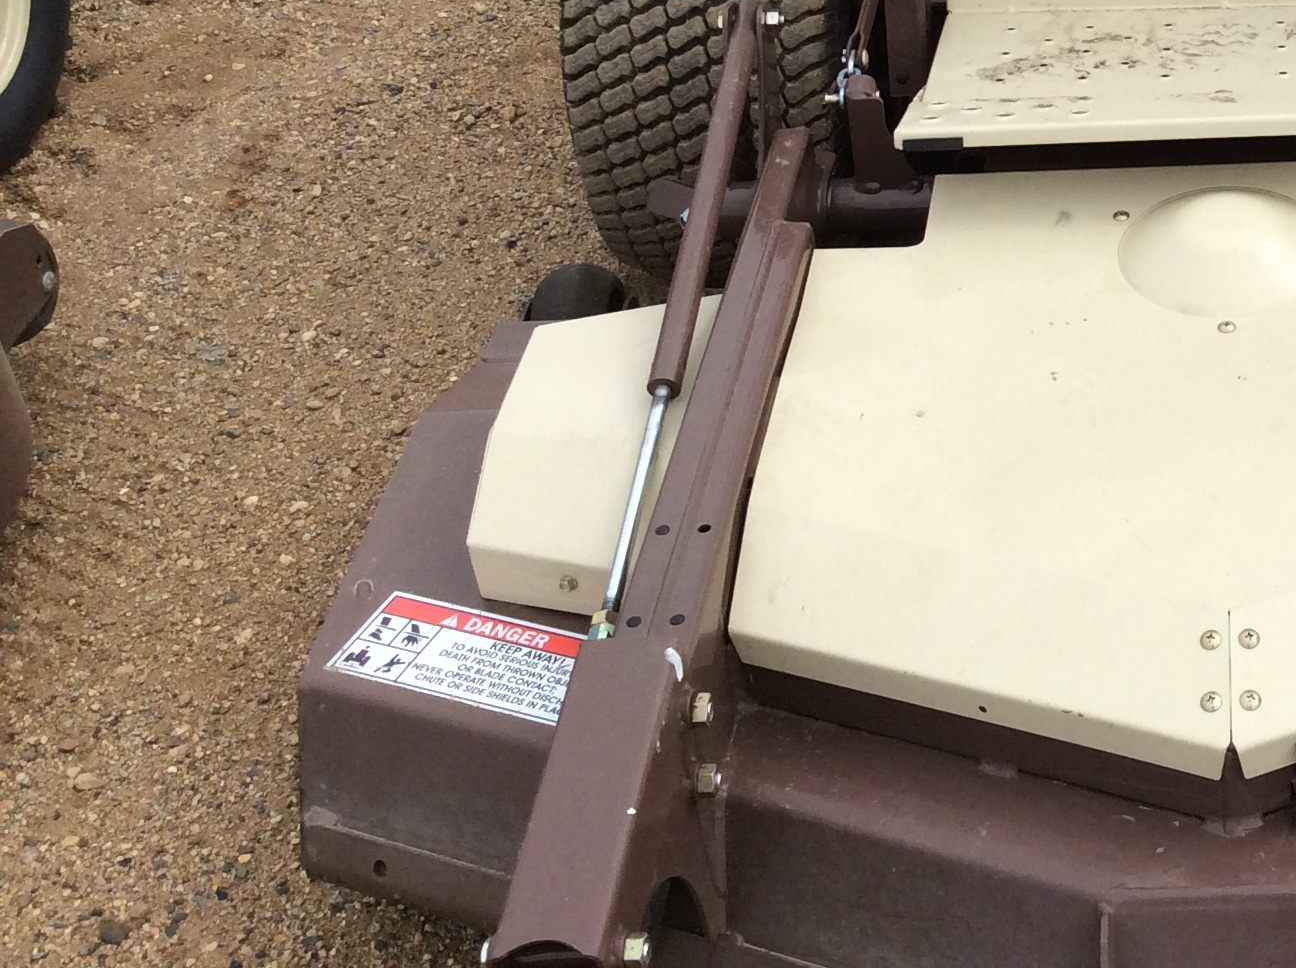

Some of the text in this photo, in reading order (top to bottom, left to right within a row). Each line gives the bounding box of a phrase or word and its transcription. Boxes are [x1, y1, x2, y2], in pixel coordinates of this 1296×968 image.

[463, 617, 550, 648] DANGER
[439, 649, 471, 662] DEATH
[471, 657, 502, 670] FROM
[502, 664, 547, 681] THROWN
[451, 642, 466, 651] TO
[466, 646, 499, 659] AVOID
[499, 654, 540, 669] SERIOUS
[489, 641, 567, 665] KEEP AWAY!
[412, 662, 444, 675] NEVER
[444, 670, 488, 686] OPERATE
[488, 680, 533, 698] WITHOUT
[457, 663, 474, 673] OR
[474, 667, 507, 681] BLADE
[414, 673, 446, 686] CHUTE
[447, 681, 463, 690] OR
[463, 685, 487, 696] SIDE
[486, 691, 526, 706] SHIELDS
[526, 700, 539, 709] IN
